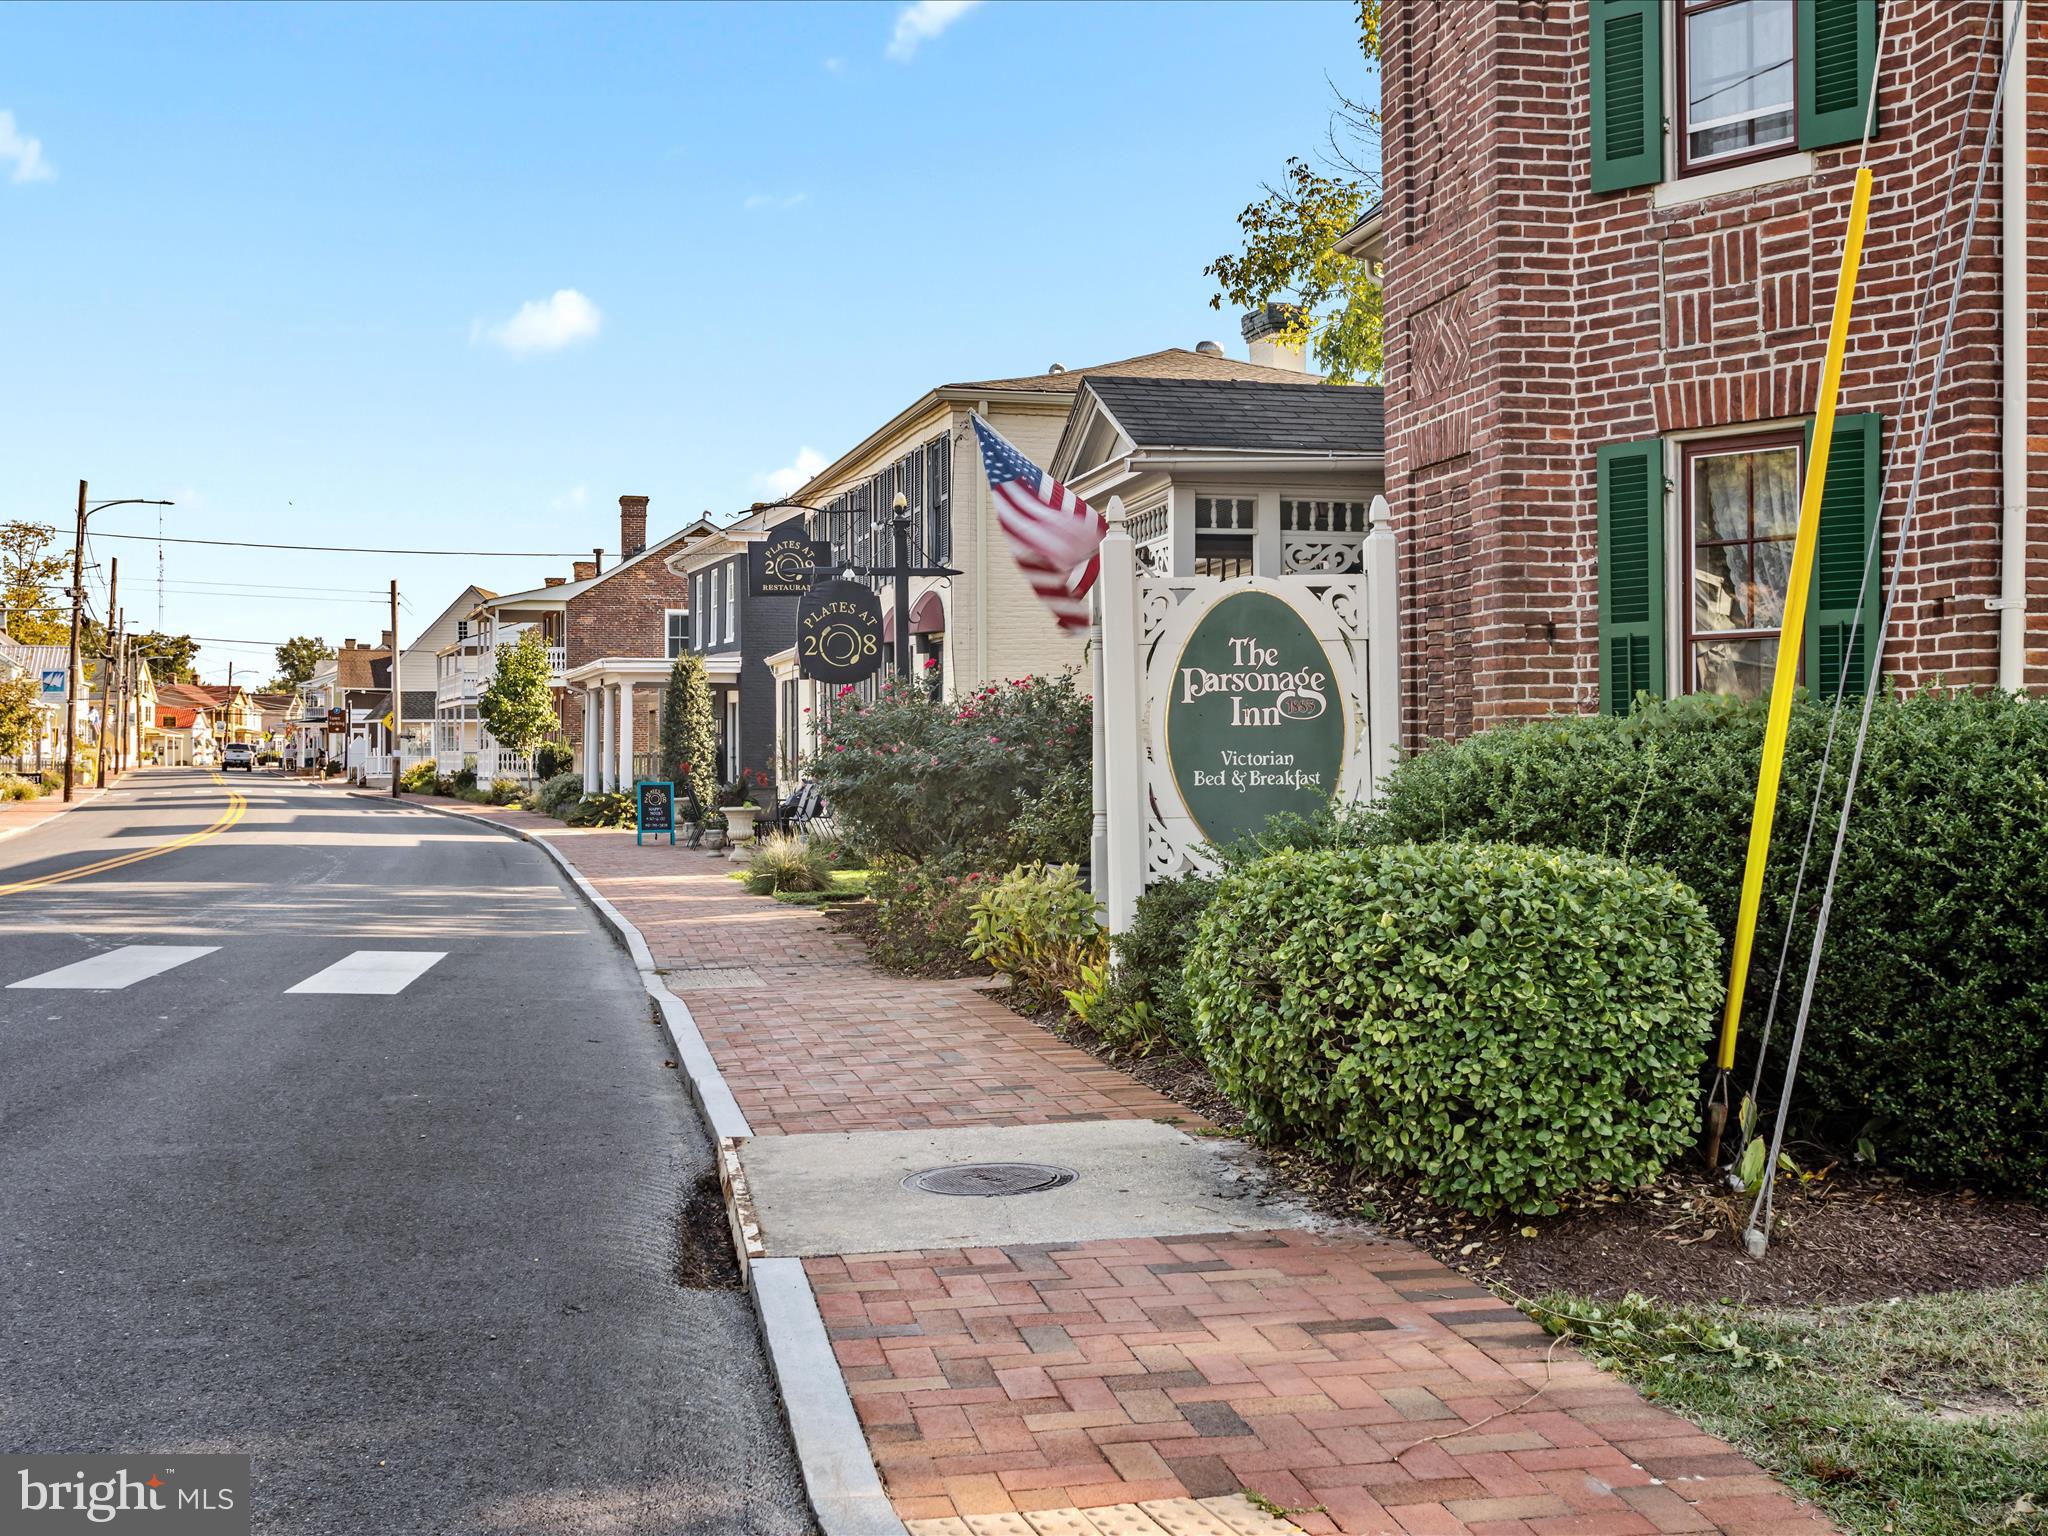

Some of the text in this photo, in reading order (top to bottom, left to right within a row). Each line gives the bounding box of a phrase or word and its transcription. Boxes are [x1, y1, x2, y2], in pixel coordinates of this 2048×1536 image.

[764, 539, 815, 559] PLATES AT
[803, 601, 878, 629] PLATES AT
[1229, 636, 1279, 670] The
[1180, 666, 1327, 720] Parsonage
[1230, 697, 1282, 727] Inn
[1221, 750, 1294, 767] Victorian
[1194, 769, 1321, 793] Bed & Breakfast
